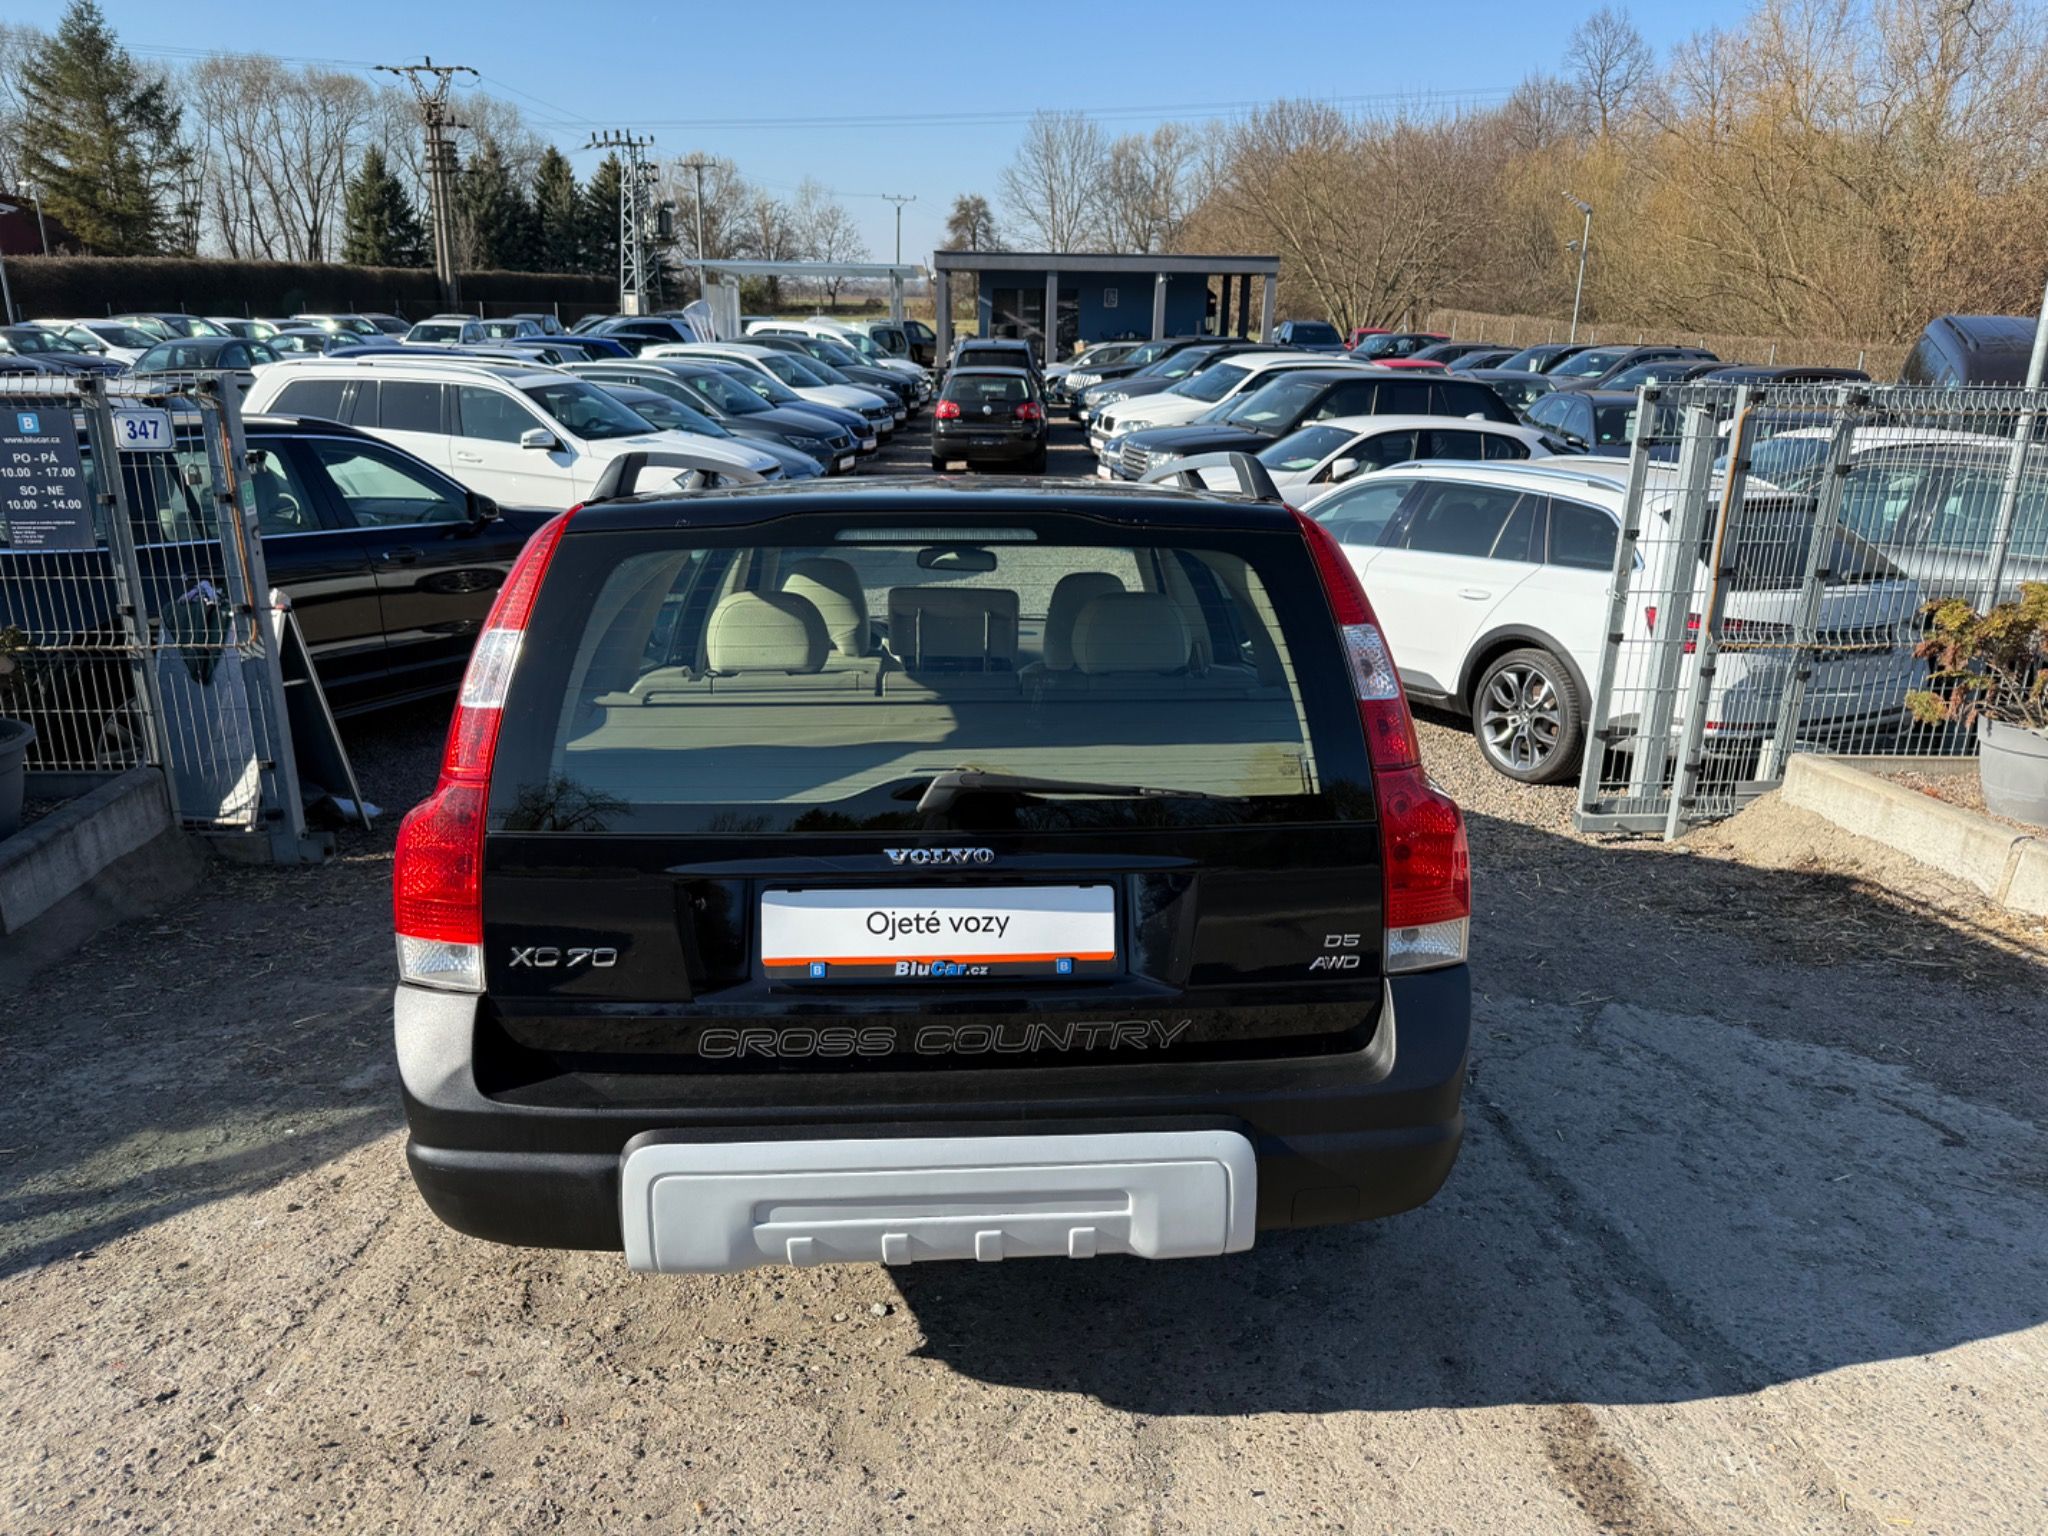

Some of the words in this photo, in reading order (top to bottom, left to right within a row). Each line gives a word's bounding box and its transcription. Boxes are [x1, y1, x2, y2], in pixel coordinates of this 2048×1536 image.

[22, 416, 34, 430] B
[126, 420, 159, 440] 347
[13, 453, 31, 463] PO
[41, 450, 59, 463] PÁ
[1, 467, 31, 477] 10.00
[45, 467, 76, 477] 17.00
[20, 485, 37, 496] SO
[47, 486, 65, 496] NE
[7, 500, 37, 510] 10.00
[52, 500, 82, 510] 14.00
[884, 848, 994, 865] VOLVO
[866, 911, 940, 940] Ojeté
[949, 915, 1010, 938] vozy
[1324, 934, 1360, 948] D5
[895, 961, 989, 976] BluCar.cz
[1309, 955, 1360, 970] AWD
[698, 1027, 897, 1058] CROSS
[915, 1019, 1192, 1055] COUNTRY
